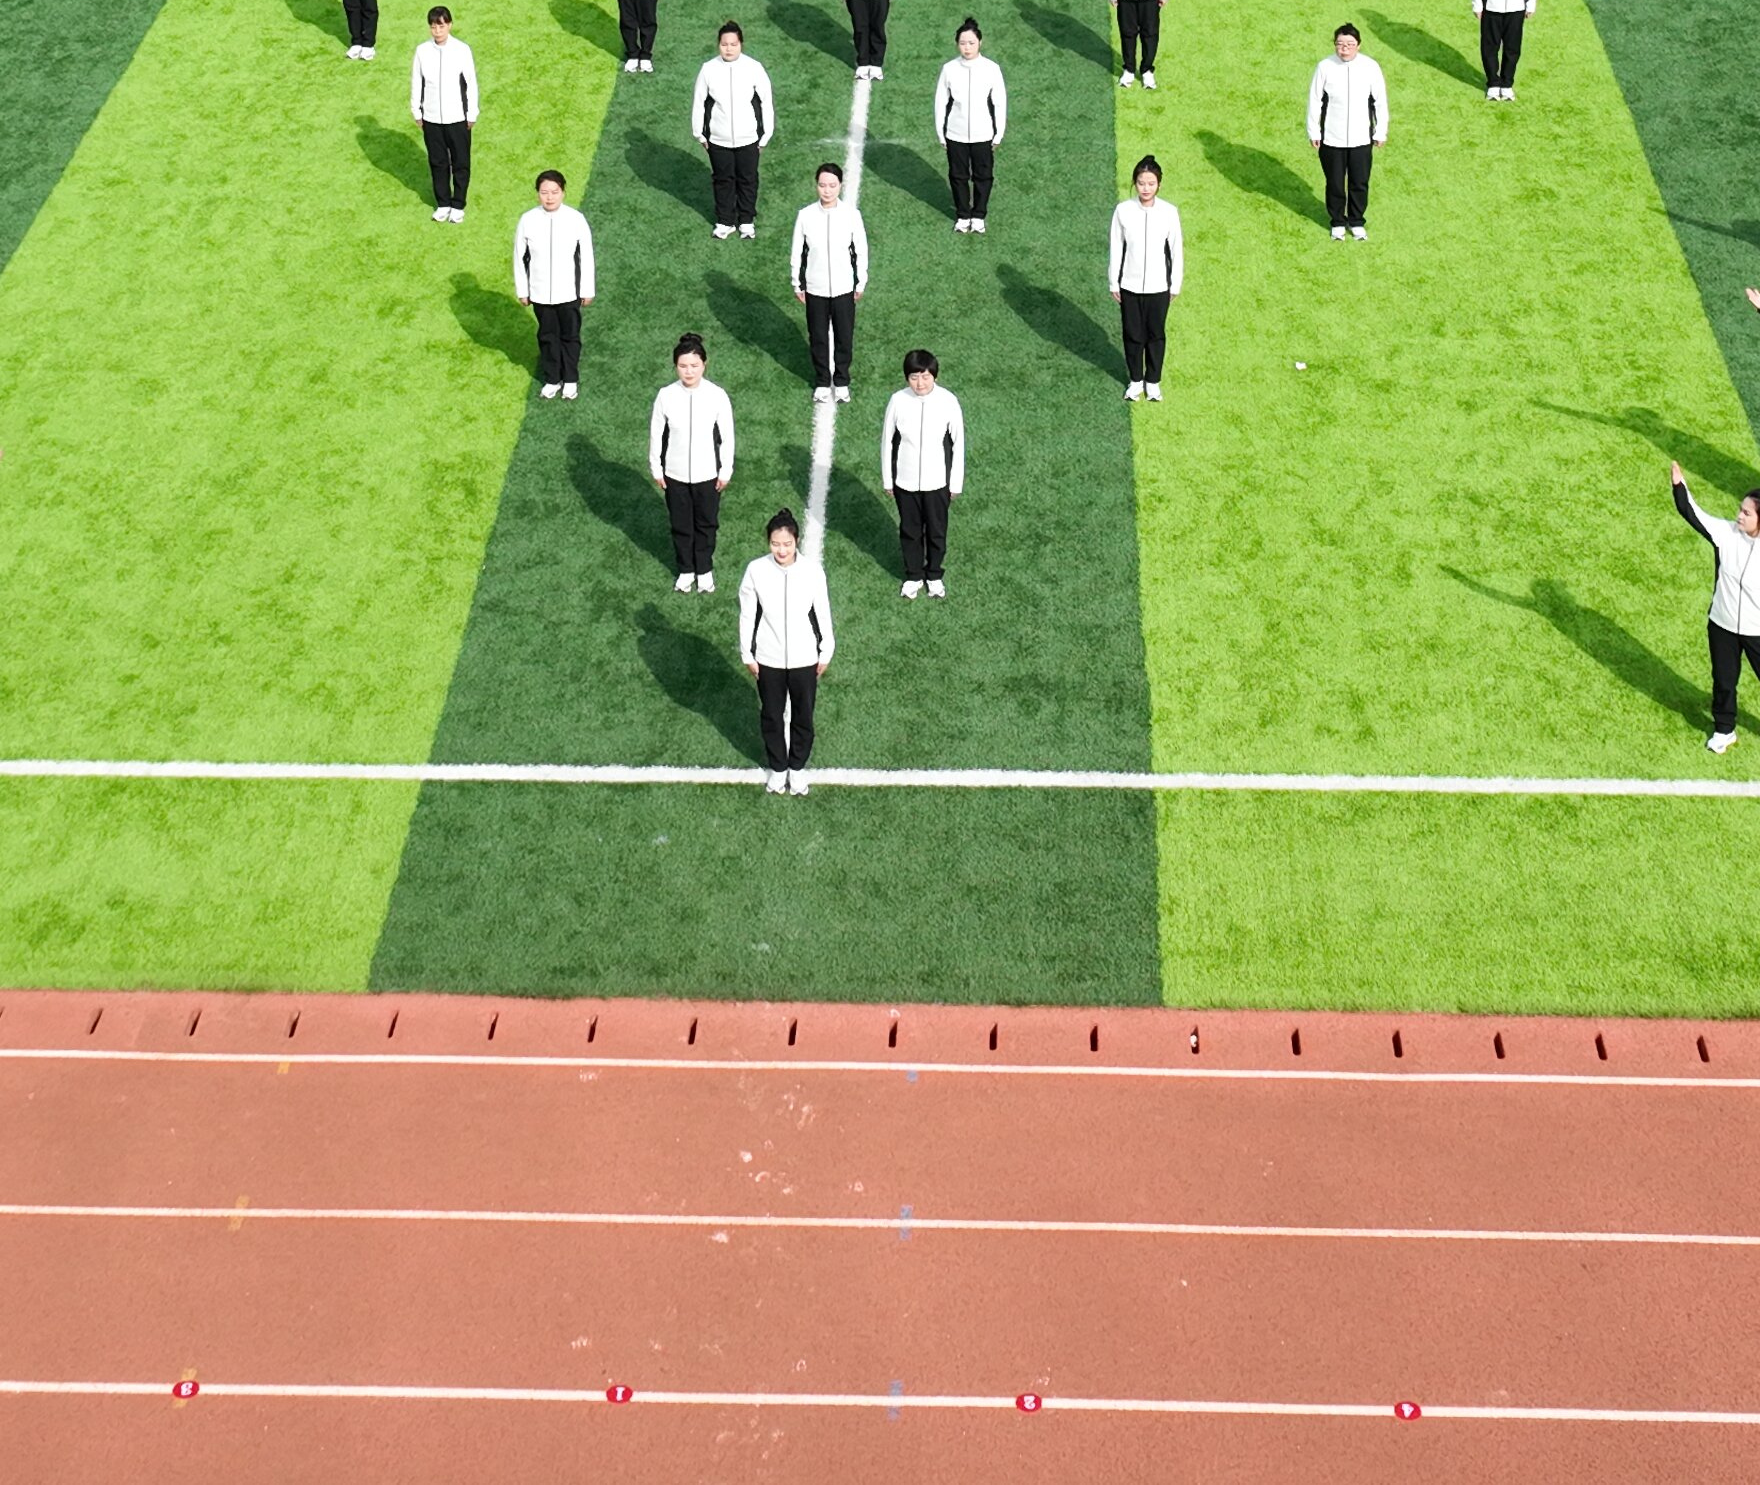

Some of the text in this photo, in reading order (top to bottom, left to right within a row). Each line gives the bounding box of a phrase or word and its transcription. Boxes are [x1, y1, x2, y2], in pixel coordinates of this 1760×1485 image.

[180, 1382, 193, 1396] 3
[616, 1386, 625, 1401] 1
[1023, 1395, 1036, 1410] 2
[1401, 1403, 1414, 1418] 4
